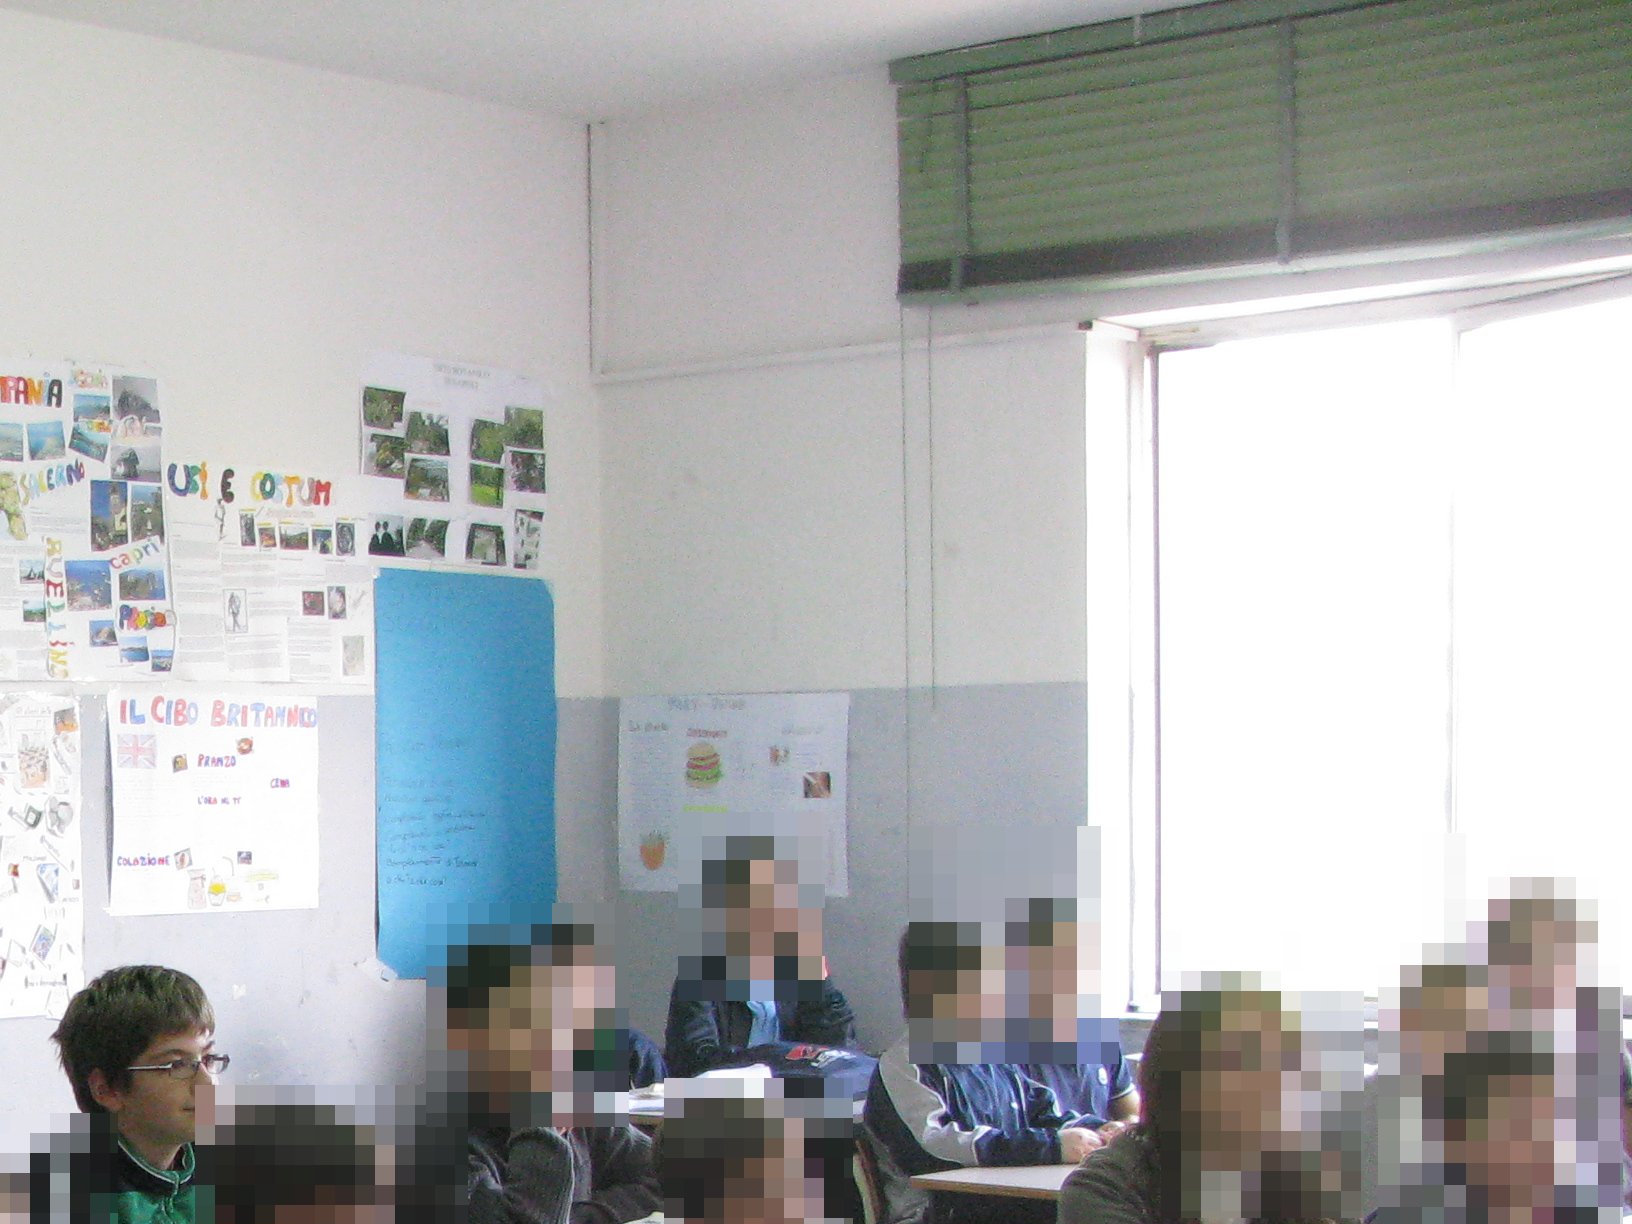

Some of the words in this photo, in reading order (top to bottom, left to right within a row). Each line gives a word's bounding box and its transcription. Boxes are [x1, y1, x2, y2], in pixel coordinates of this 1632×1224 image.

[167, 461, 208, 500] USI
[221, 468, 235, 503] E
[120, 698, 145, 725] IL
[151, 695, 198, 726] CIBO
[197, 753, 237, 768] PRANZO
[116, 853, 171, 867] COLAZIONE
